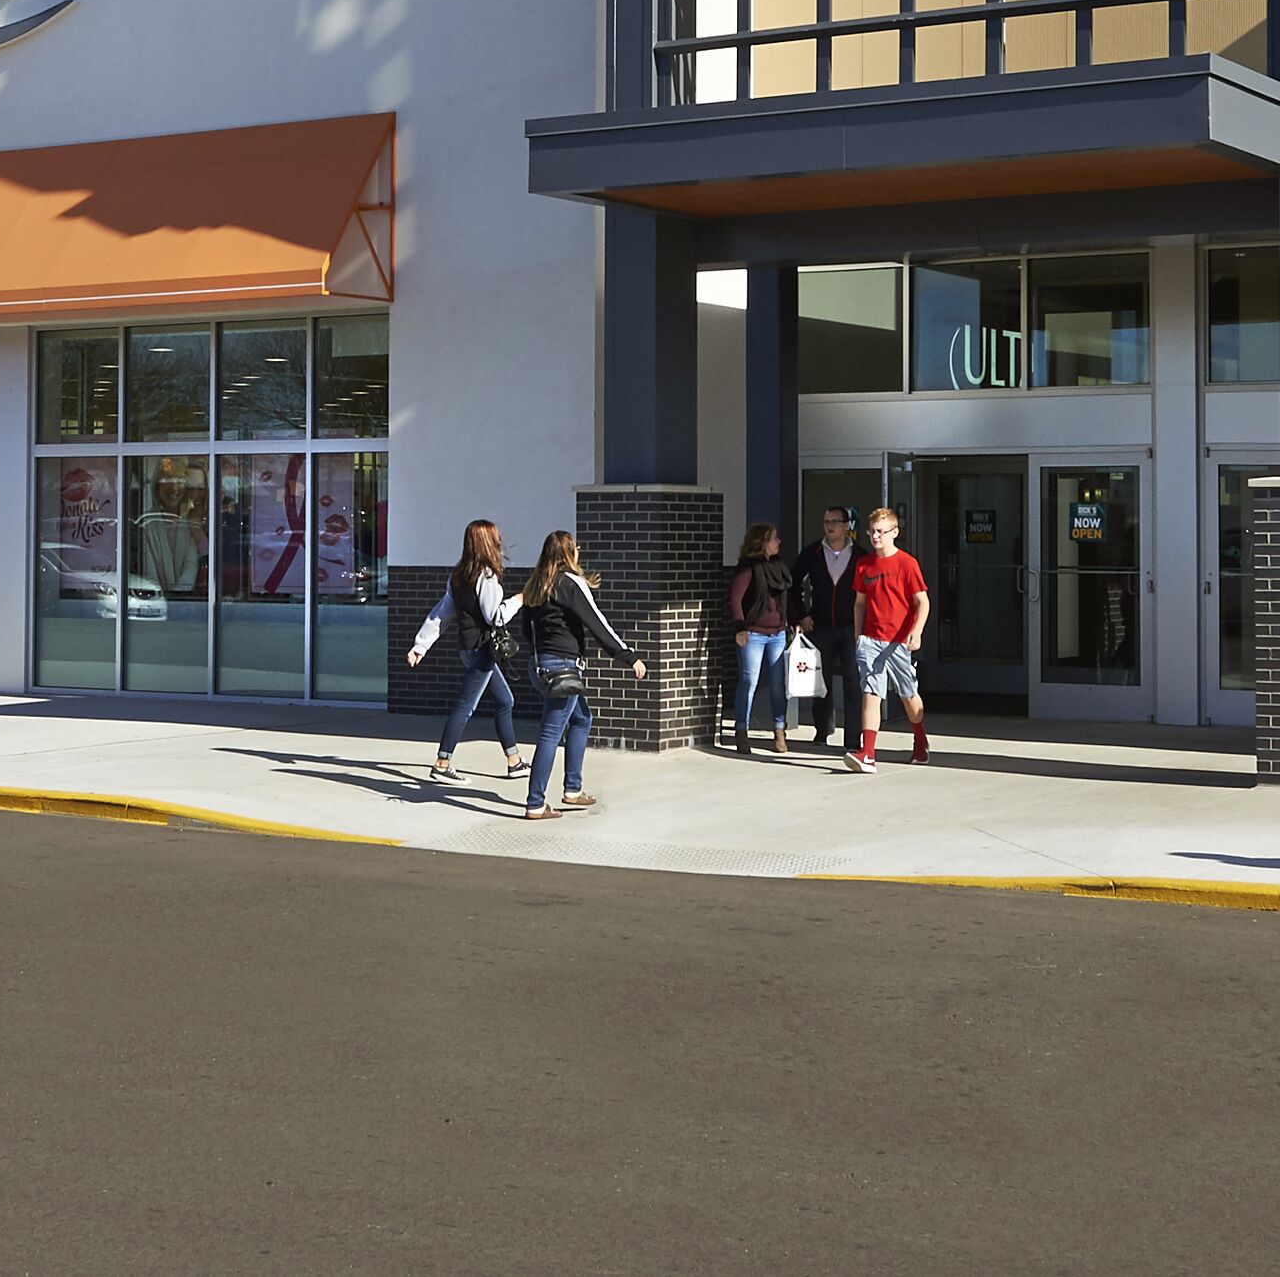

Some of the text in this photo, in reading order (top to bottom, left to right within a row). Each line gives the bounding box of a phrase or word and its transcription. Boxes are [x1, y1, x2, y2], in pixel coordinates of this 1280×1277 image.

[963, 324, 1034, 388] ULT
[72, 515, 105, 543] Kiss
[1074, 517, 1101, 529] NOW
[1072, 528, 1102, 539] OPEN
